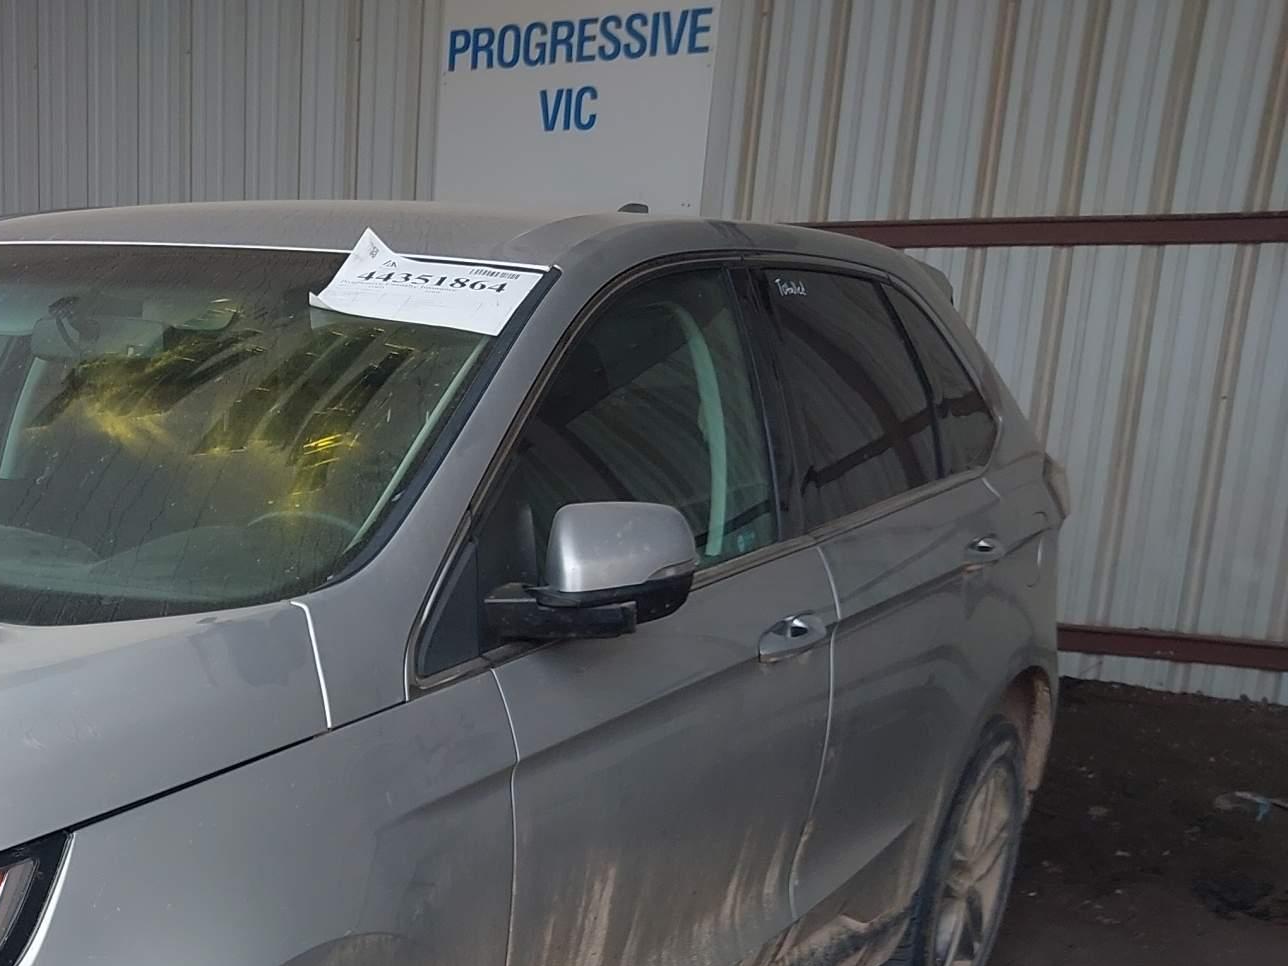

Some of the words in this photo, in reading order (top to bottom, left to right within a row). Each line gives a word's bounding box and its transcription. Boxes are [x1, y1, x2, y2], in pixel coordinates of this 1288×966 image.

[448, 7, 713, 72] PROGRESSIVE
[539, 85, 598, 132] VIC
[356, 270, 507, 294] 44351864
